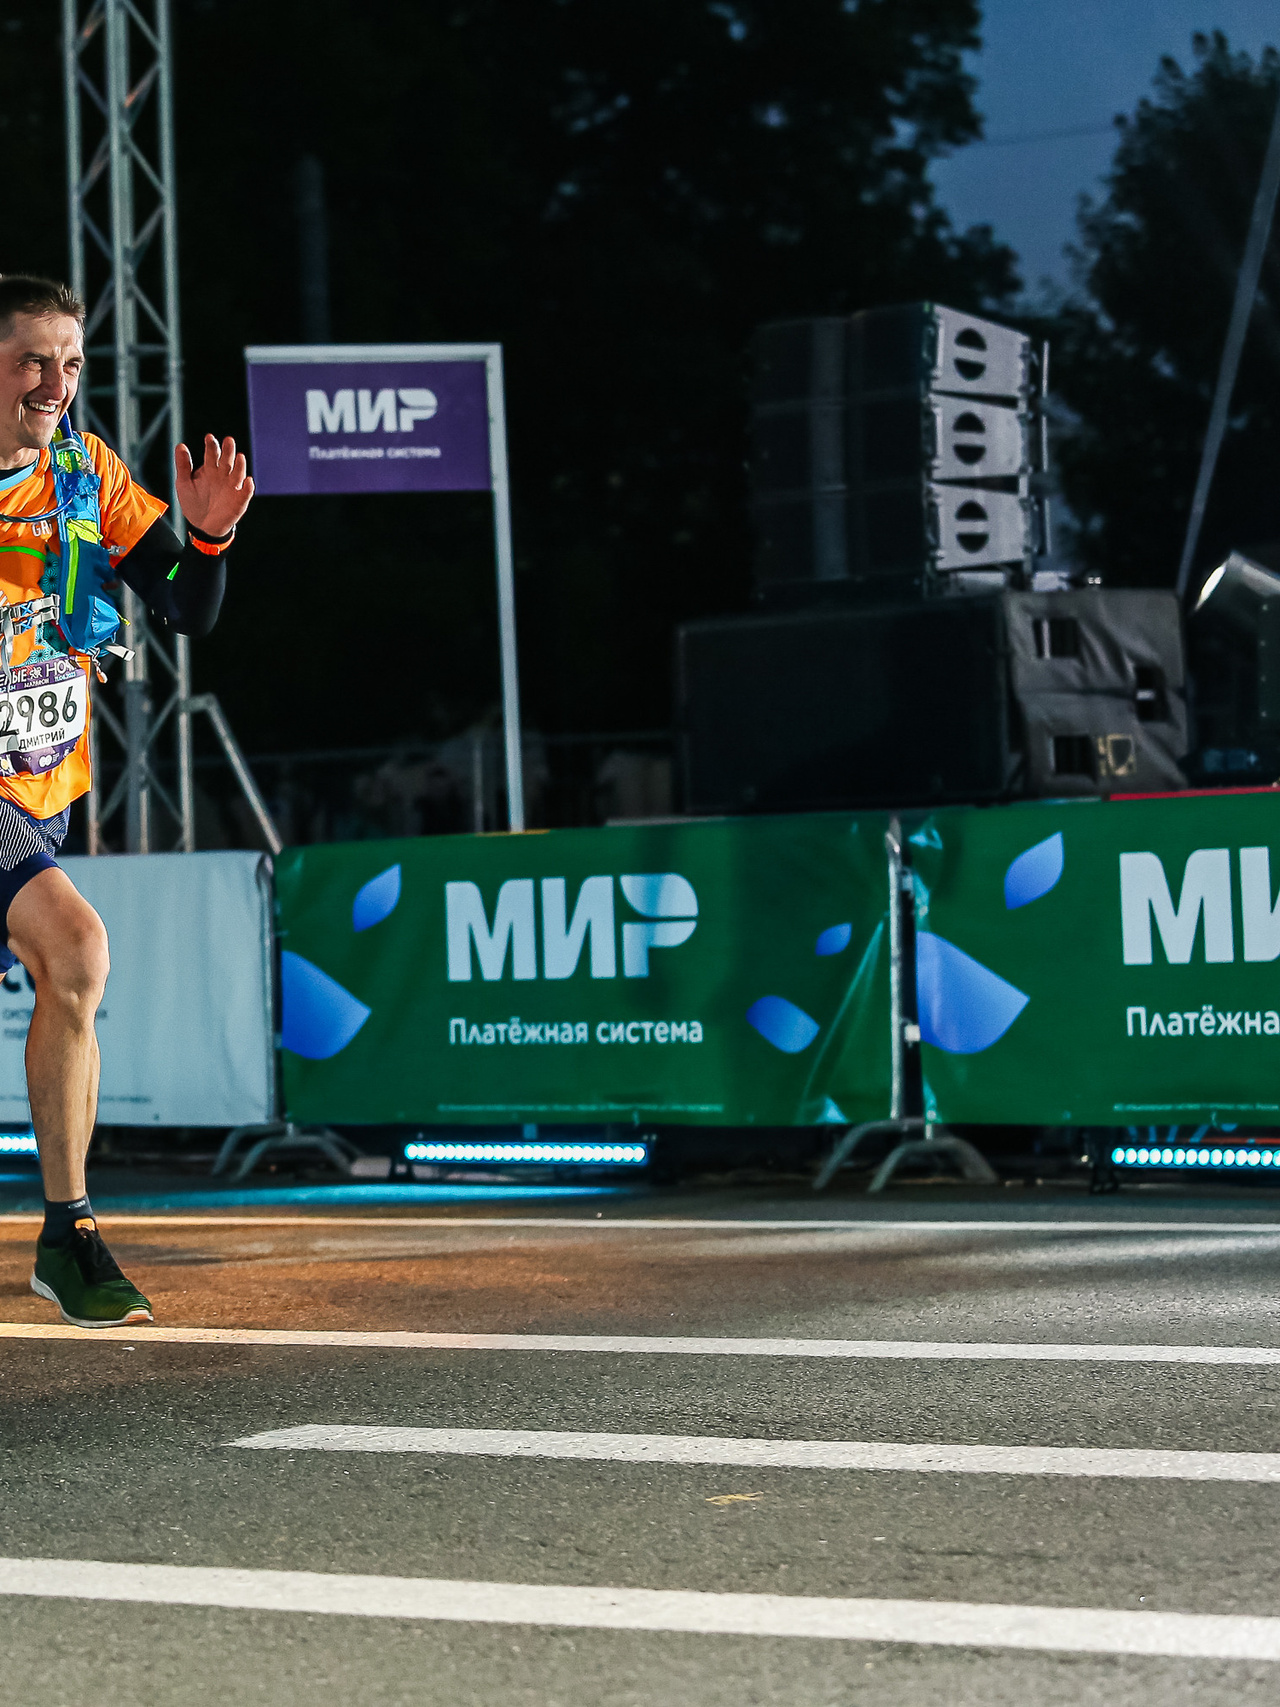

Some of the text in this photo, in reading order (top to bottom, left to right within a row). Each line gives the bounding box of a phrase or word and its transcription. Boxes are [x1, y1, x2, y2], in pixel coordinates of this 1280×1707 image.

[305, 388, 438, 433] МИР
[19, 728, 66, 752] ДМИТРИЙ
[445, 872, 699, 982] МИР
[449, 1016, 704, 1045] Платёжная система
[1126, 1004, 1280, 1036] Платёжна
